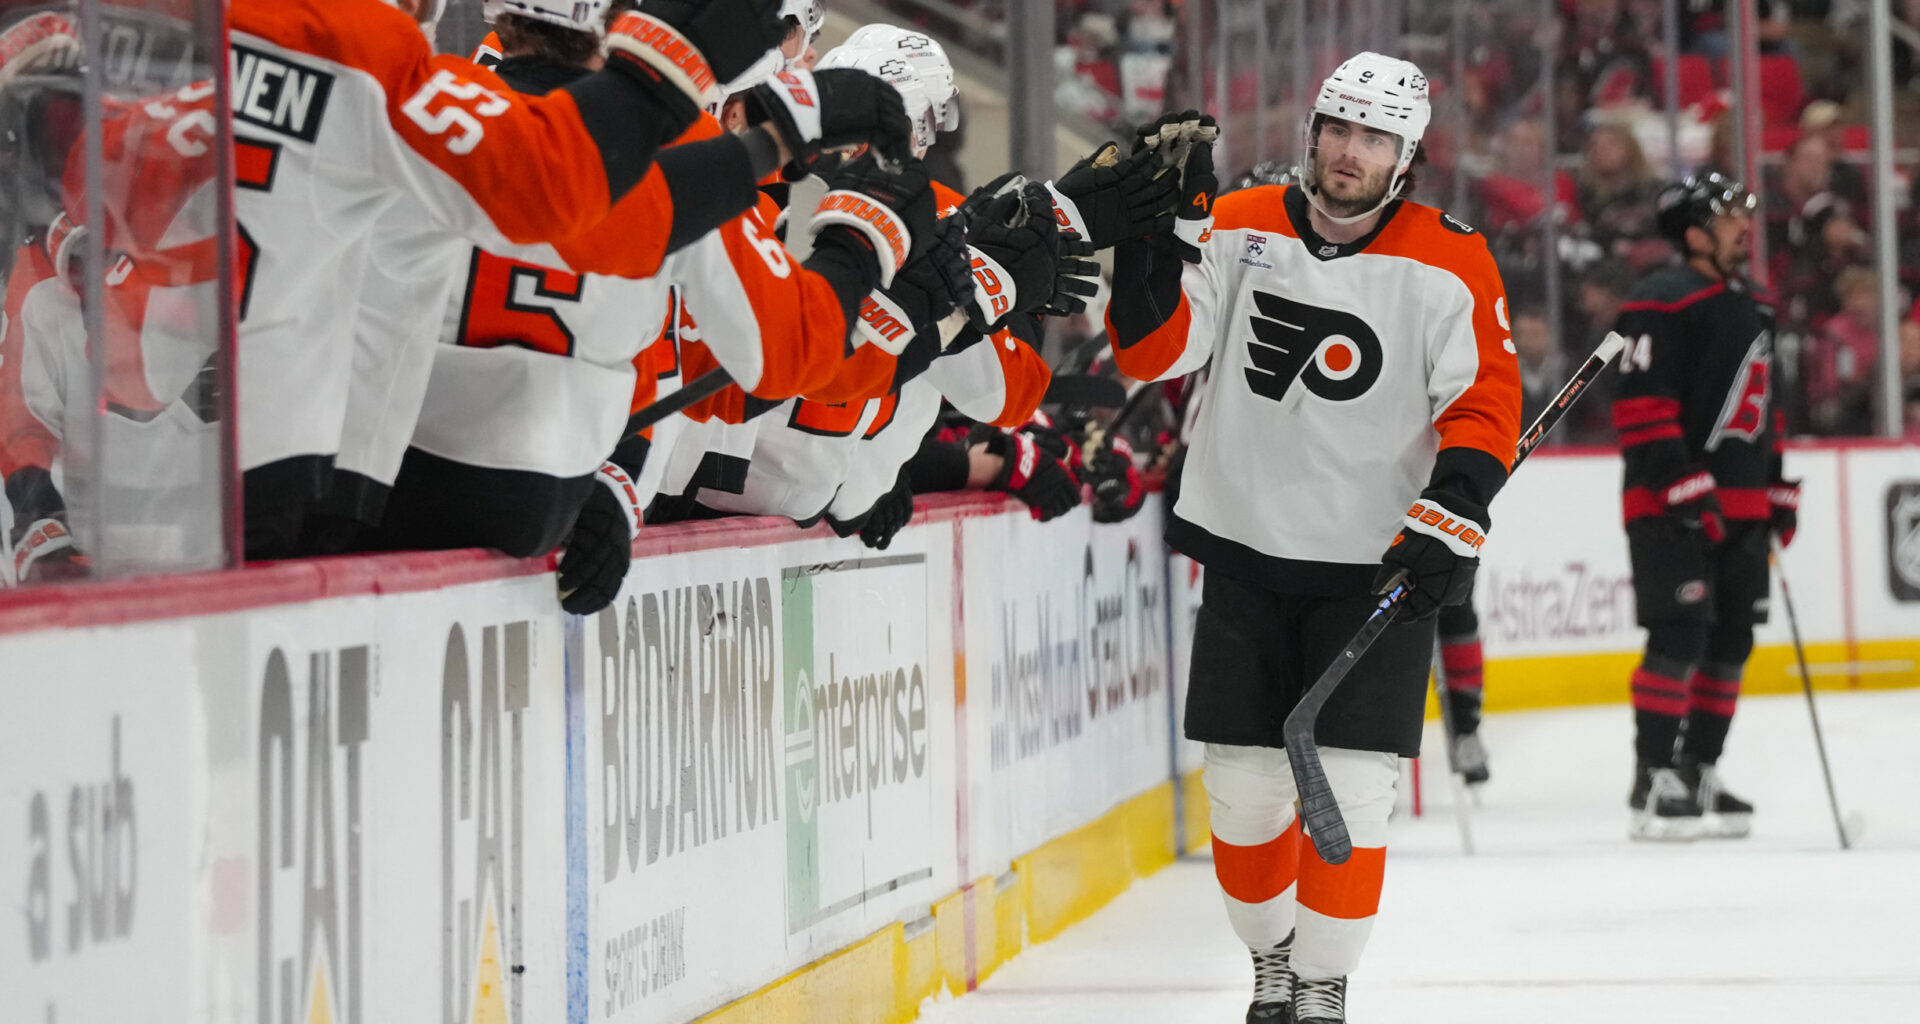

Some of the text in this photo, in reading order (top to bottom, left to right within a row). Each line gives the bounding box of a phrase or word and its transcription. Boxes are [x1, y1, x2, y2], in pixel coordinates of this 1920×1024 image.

[742, 205, 792, 279] 6
[27, 714, 138, 963] a sub
[258, 643, 370, 1024] CAT
[441, 620, 531, 1024] CAT
[601, 576, 779, 885] BODYARMOR
[783, 622, 927, 840] enterprise
[605, 906, 686, 1018] SPORTS DRINK
